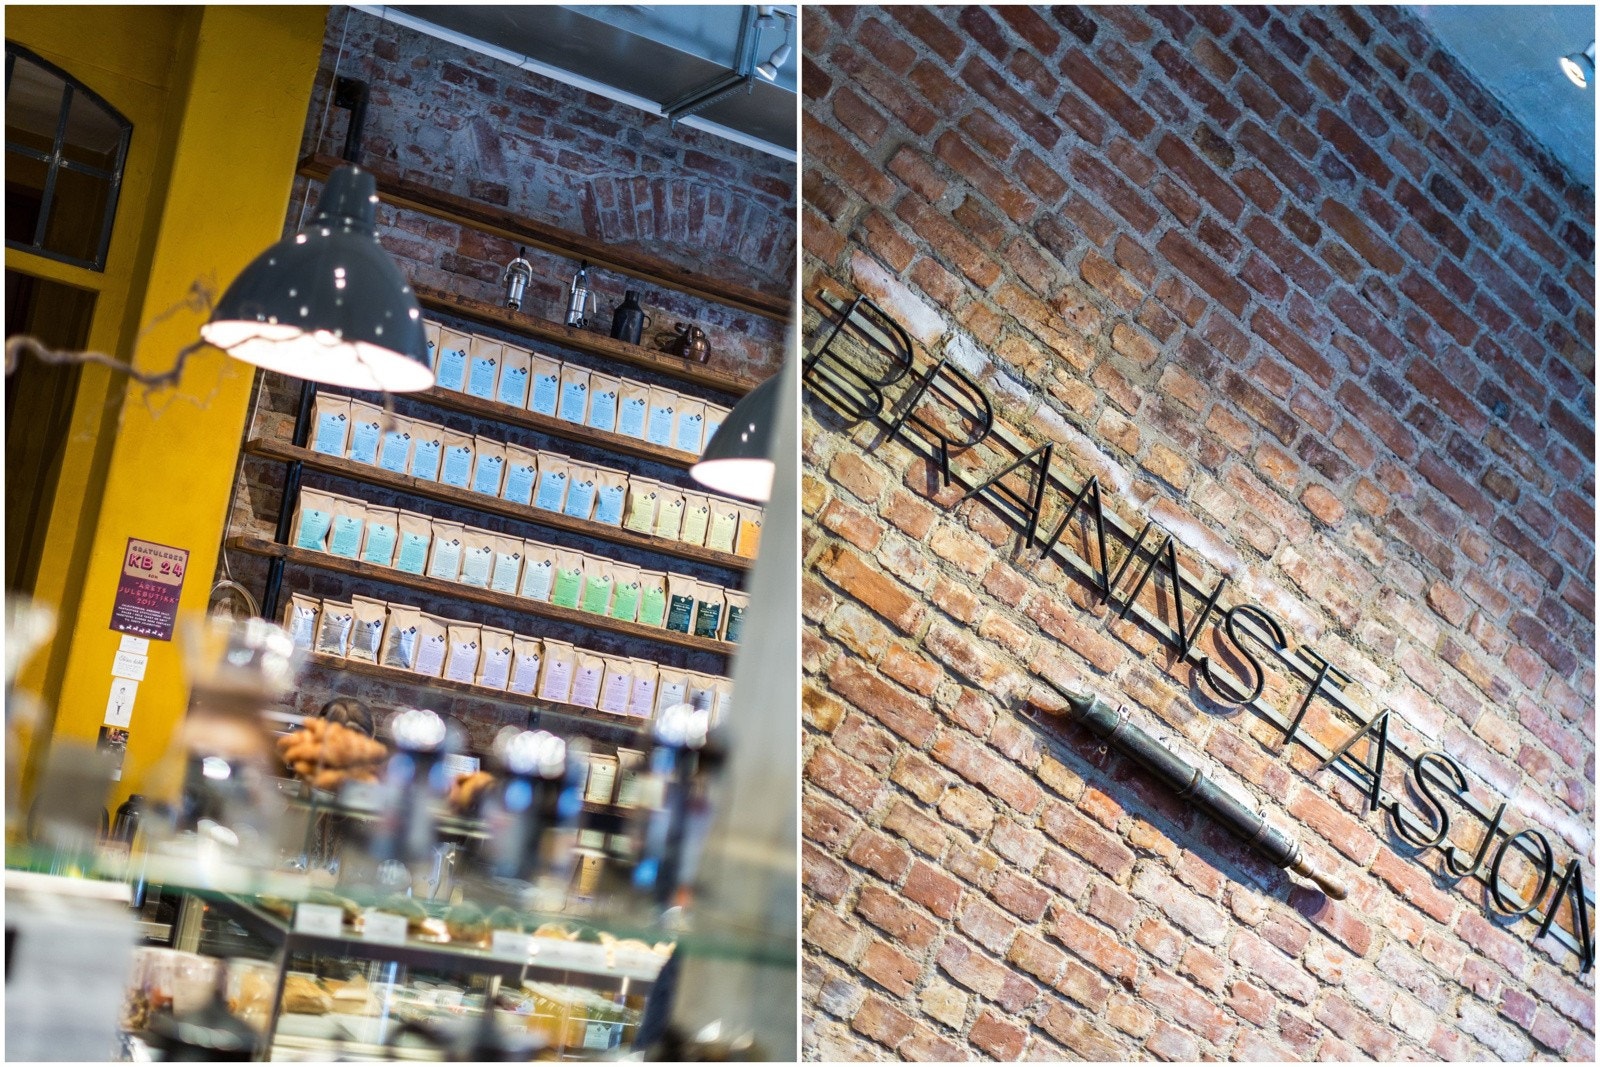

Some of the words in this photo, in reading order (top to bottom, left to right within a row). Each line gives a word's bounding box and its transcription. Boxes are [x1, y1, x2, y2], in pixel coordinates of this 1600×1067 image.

[133, 545, 183, 562] GRATULERER
[128, 553, 153, 571] KB
[160, 560, 183, 577] 24
[136, 598, 157, 607] 2017
